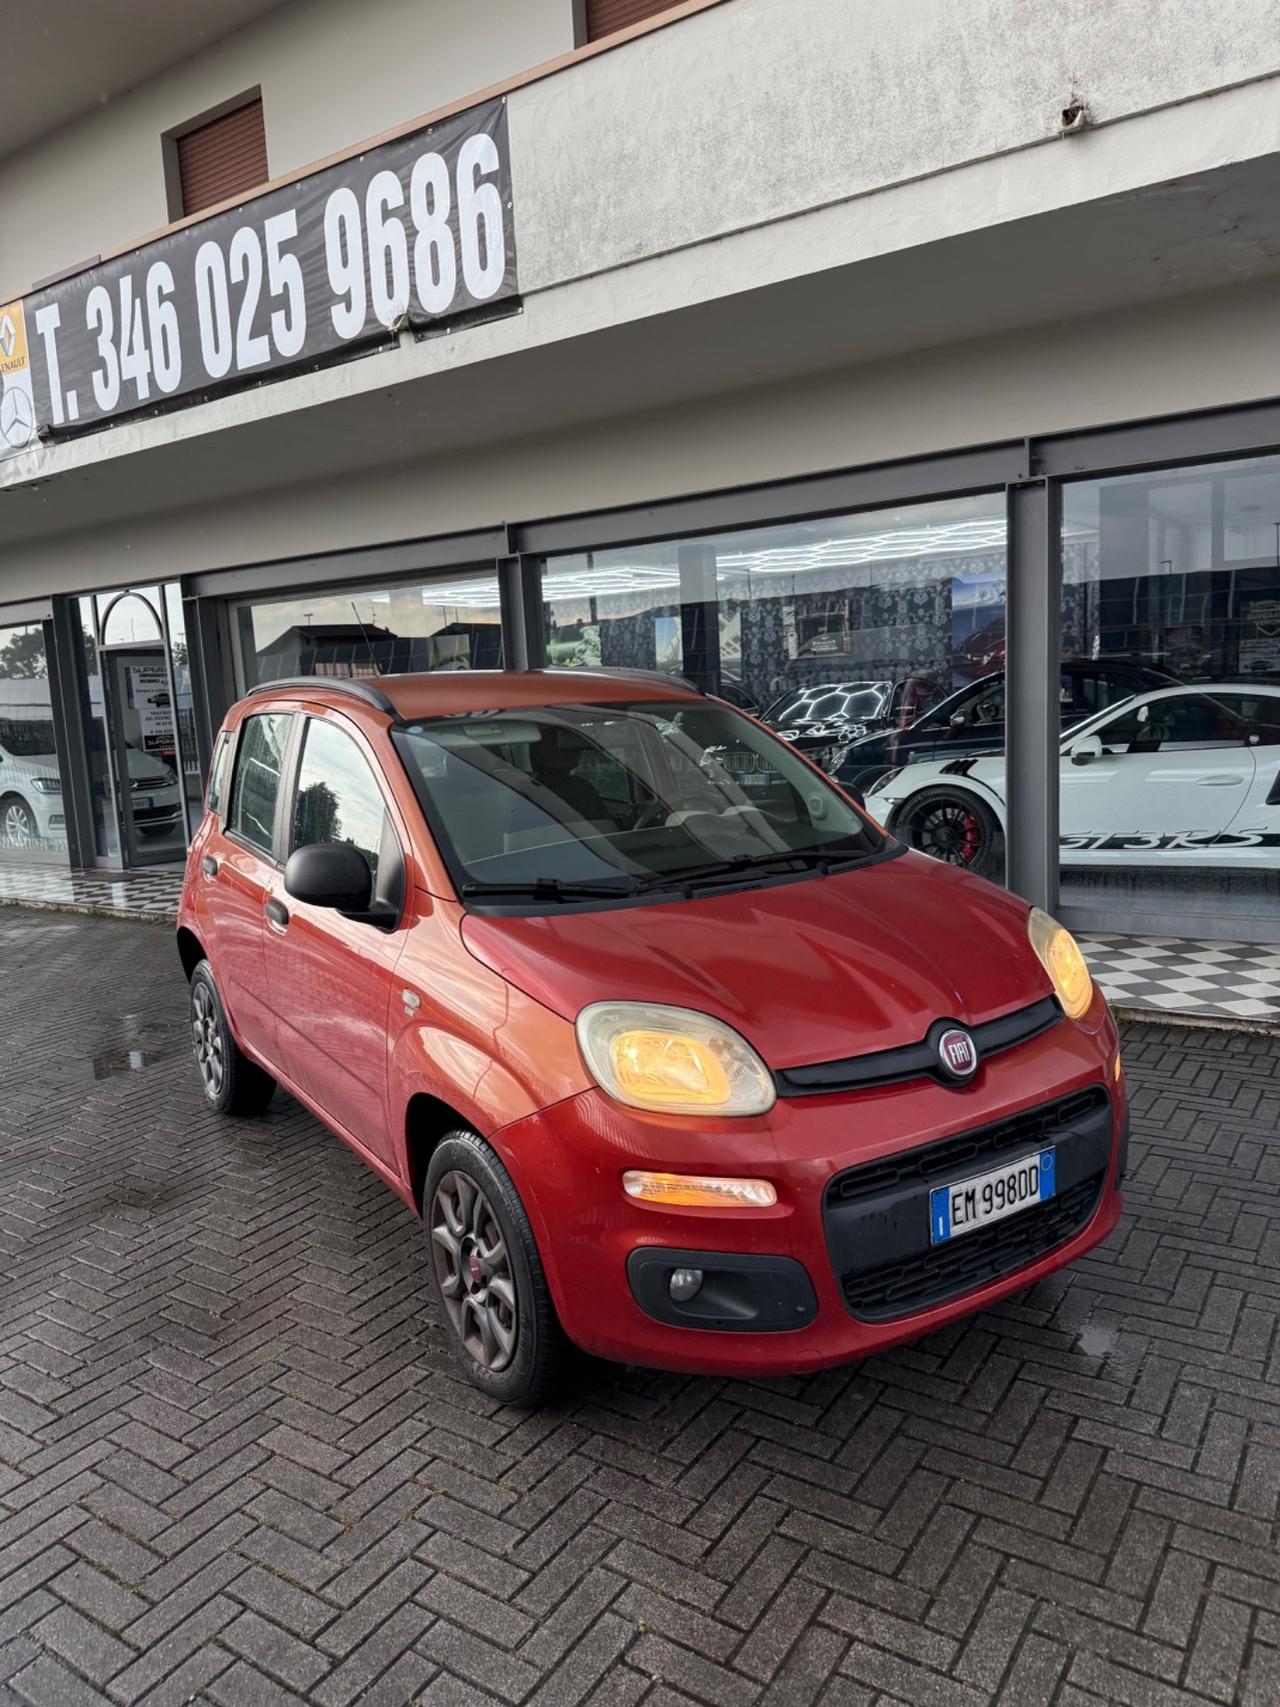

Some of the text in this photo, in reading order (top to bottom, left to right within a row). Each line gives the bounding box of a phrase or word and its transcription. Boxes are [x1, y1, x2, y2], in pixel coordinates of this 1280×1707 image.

[35, 132, 506, 425] T. 346 025 9686
[1, 356, 25, 373] ENAULT
[948, 1041, 971, 1064] FIAT
